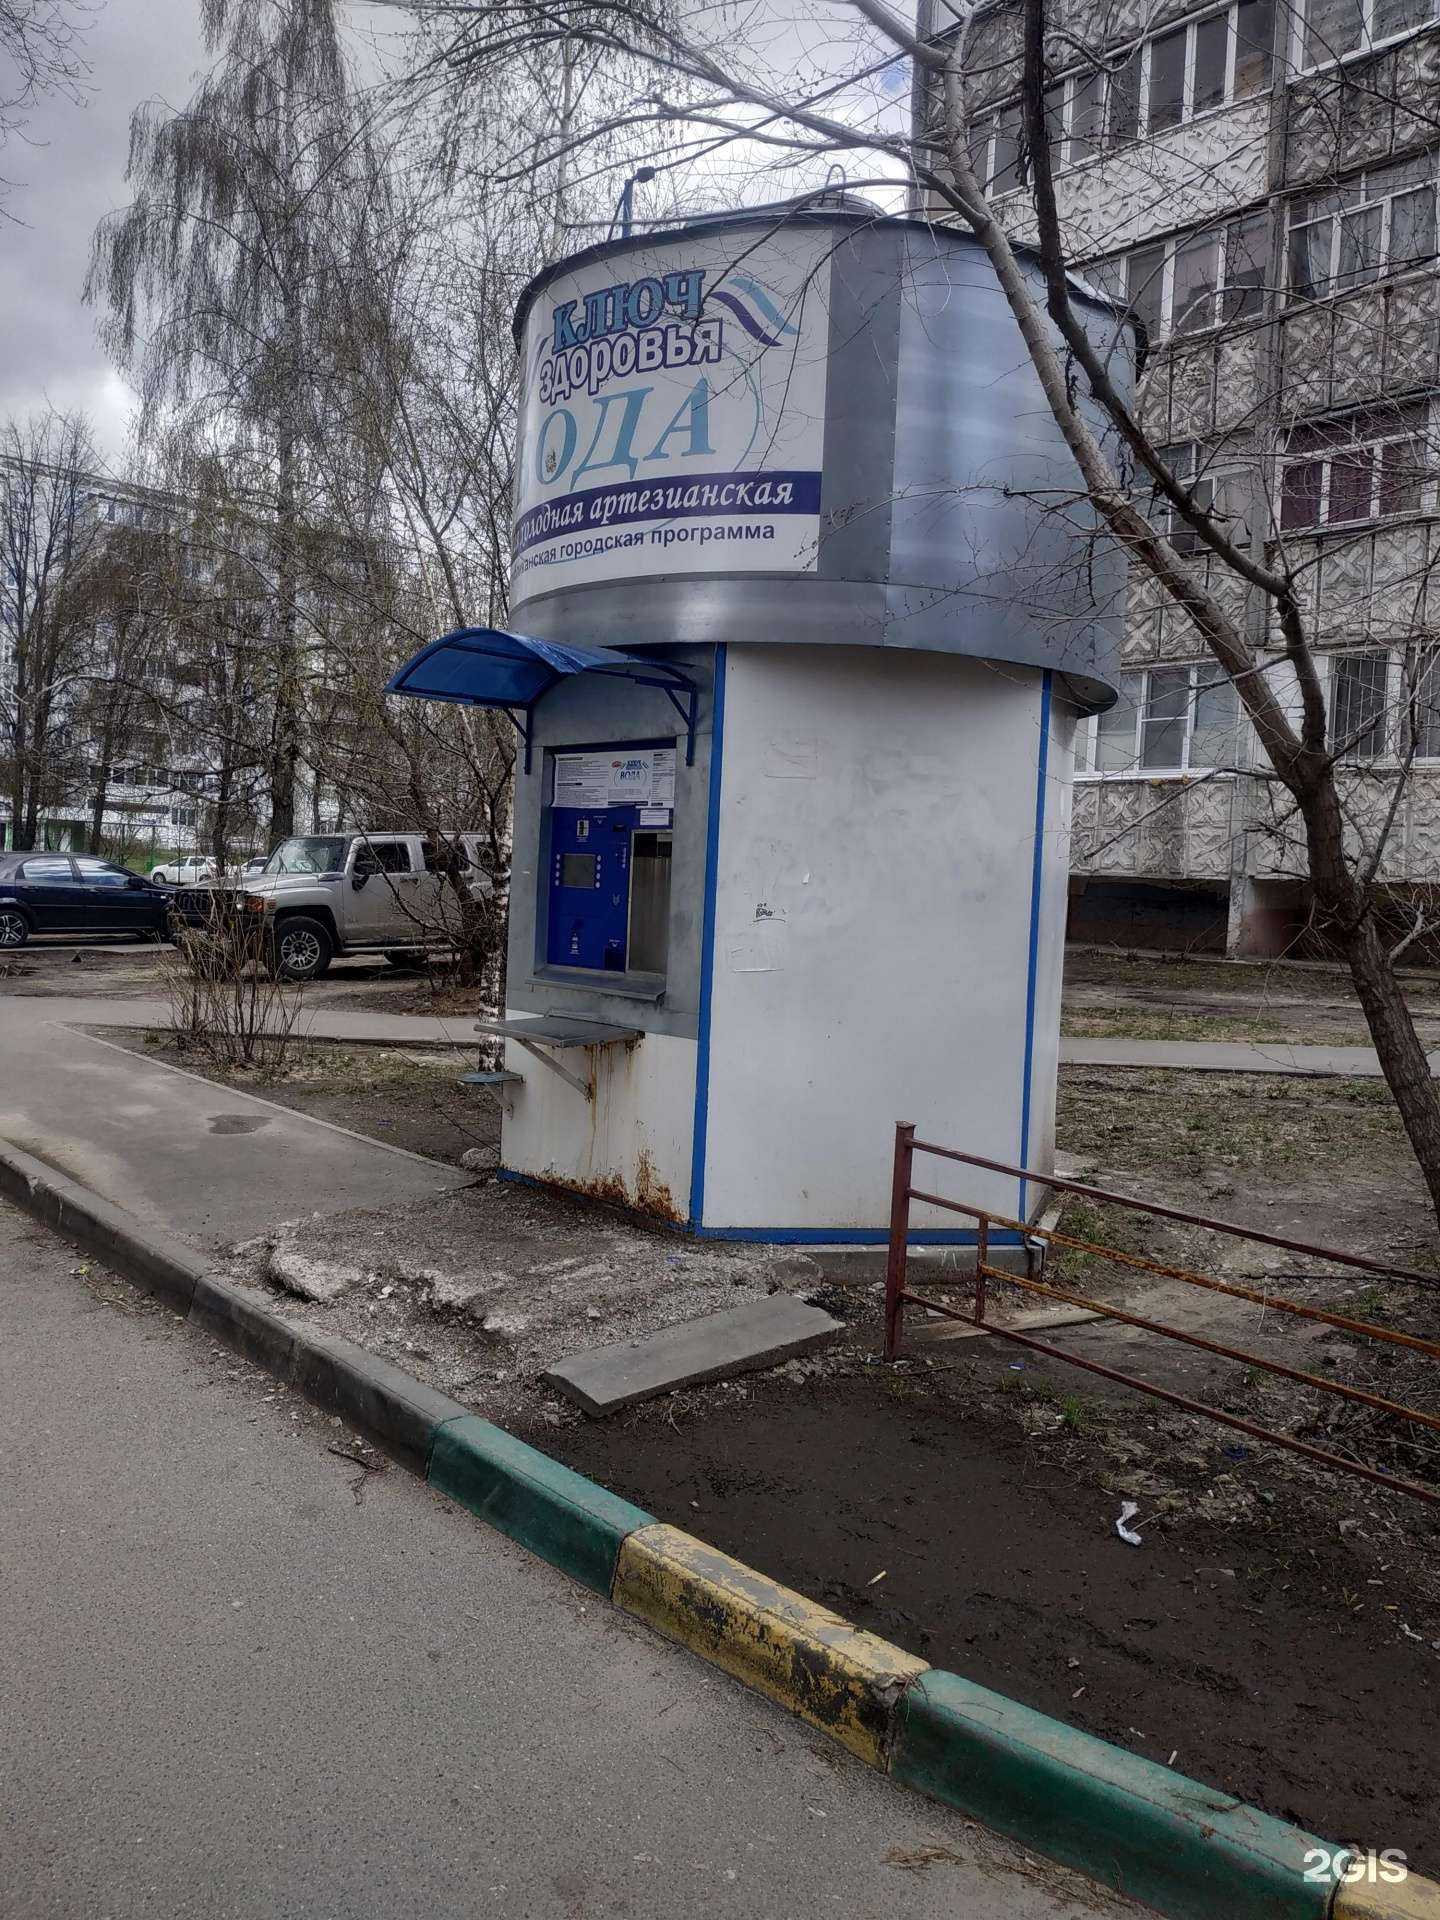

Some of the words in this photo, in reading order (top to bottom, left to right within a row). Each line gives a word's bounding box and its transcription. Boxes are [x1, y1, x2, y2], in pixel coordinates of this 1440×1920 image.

[552, 270, 706, 355] КЛЮЧ
[590, 481, 794, 525] артезианская
[560, 532, 644, 559] городская
[651, 522, 775, 547] программа
